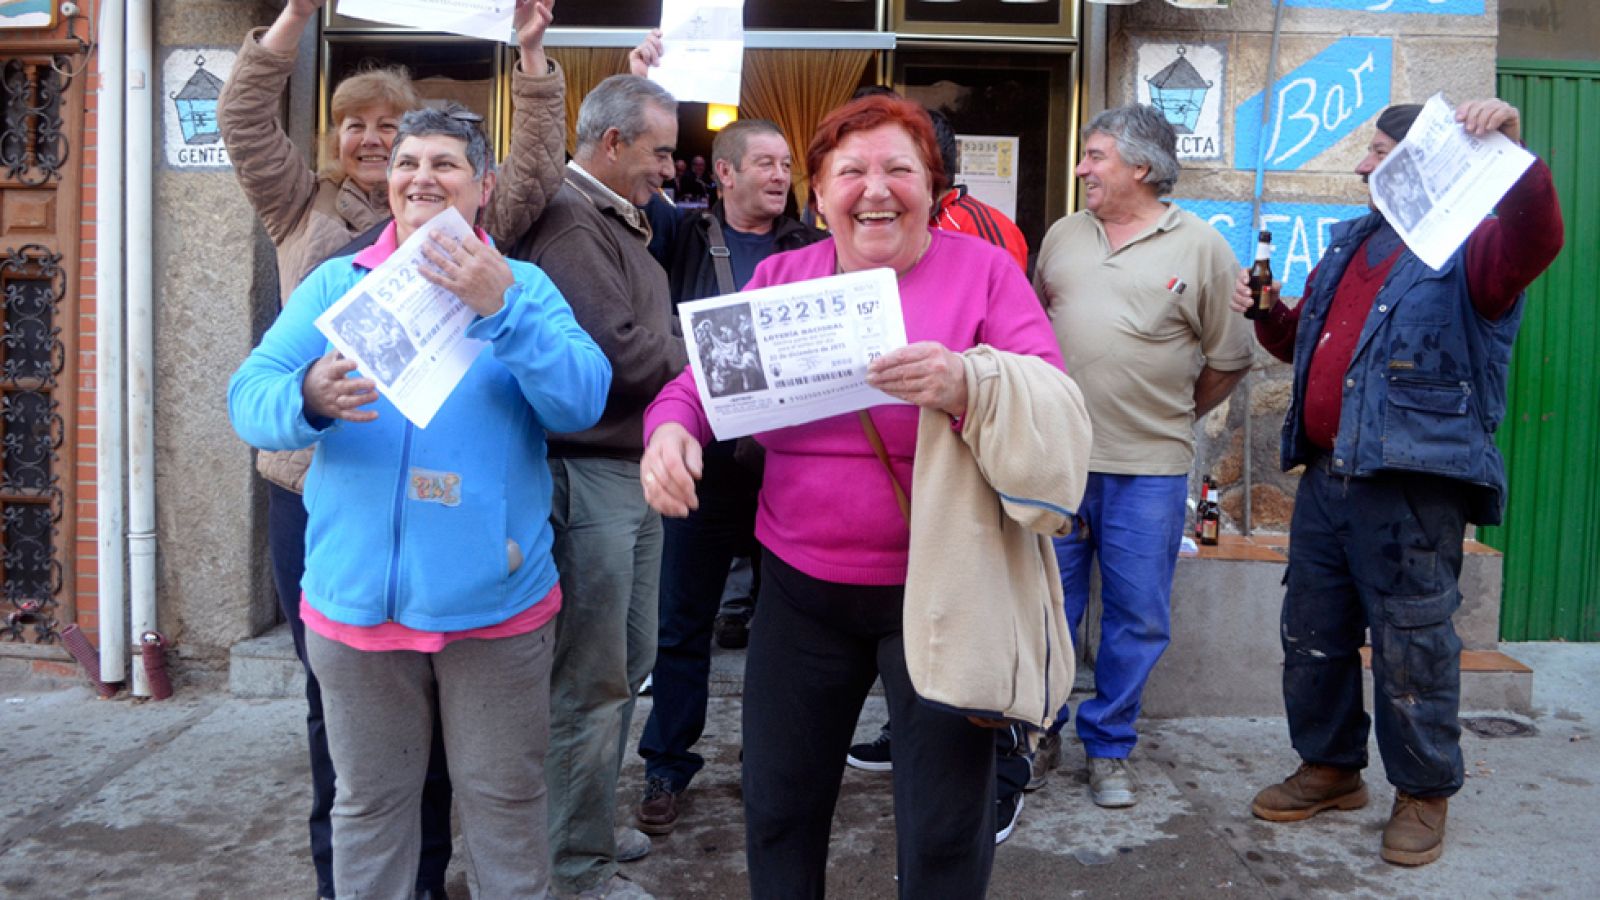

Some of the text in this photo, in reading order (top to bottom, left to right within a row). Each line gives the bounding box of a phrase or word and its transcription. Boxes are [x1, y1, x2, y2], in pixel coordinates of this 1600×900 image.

[1264, 57, 1373, 166] Bar
[177, 147, 226, 163] GENTE
[760, 295, 847, 326] 52215
